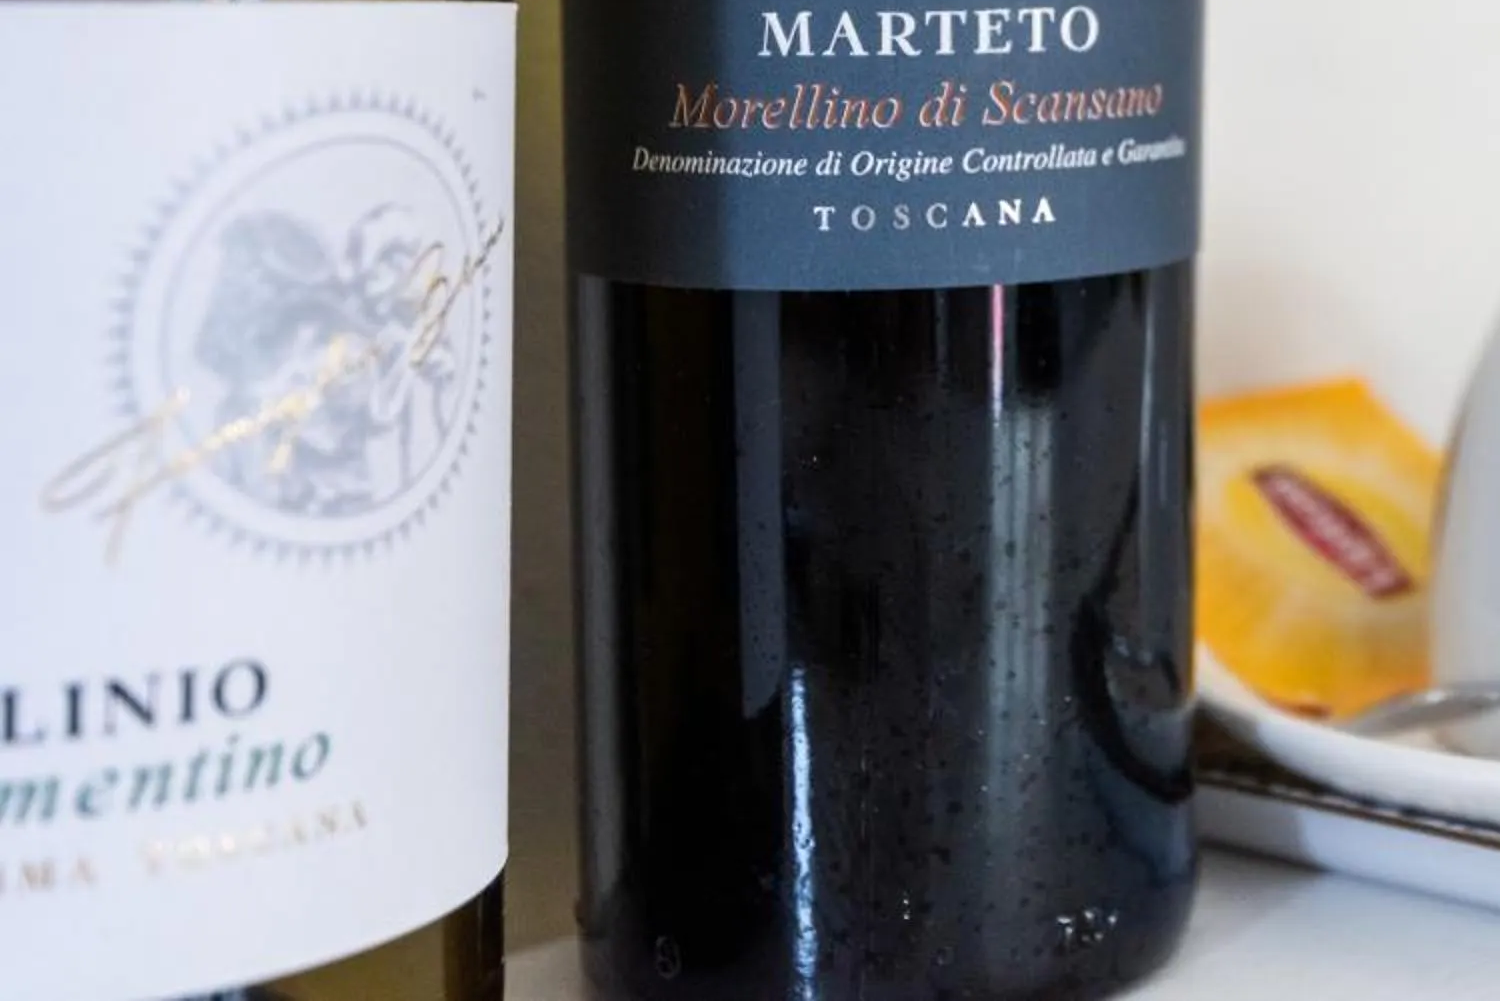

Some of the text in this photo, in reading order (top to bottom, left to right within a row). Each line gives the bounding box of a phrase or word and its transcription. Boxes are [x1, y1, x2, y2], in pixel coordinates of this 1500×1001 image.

[758, 4, 1100, 58] MARTETO
[669, 78, 1164, 130] Morellino di Scansano
[632, 145, 808, 178] Denominazione
[815, 149, 842, 176] di
[850, 149, 953, 183] Origine
[962, 144, 1097, 175] Controllata
[1101, 146, 1114, 166] e
[813, 198, 1056, 231] TOSCANA
